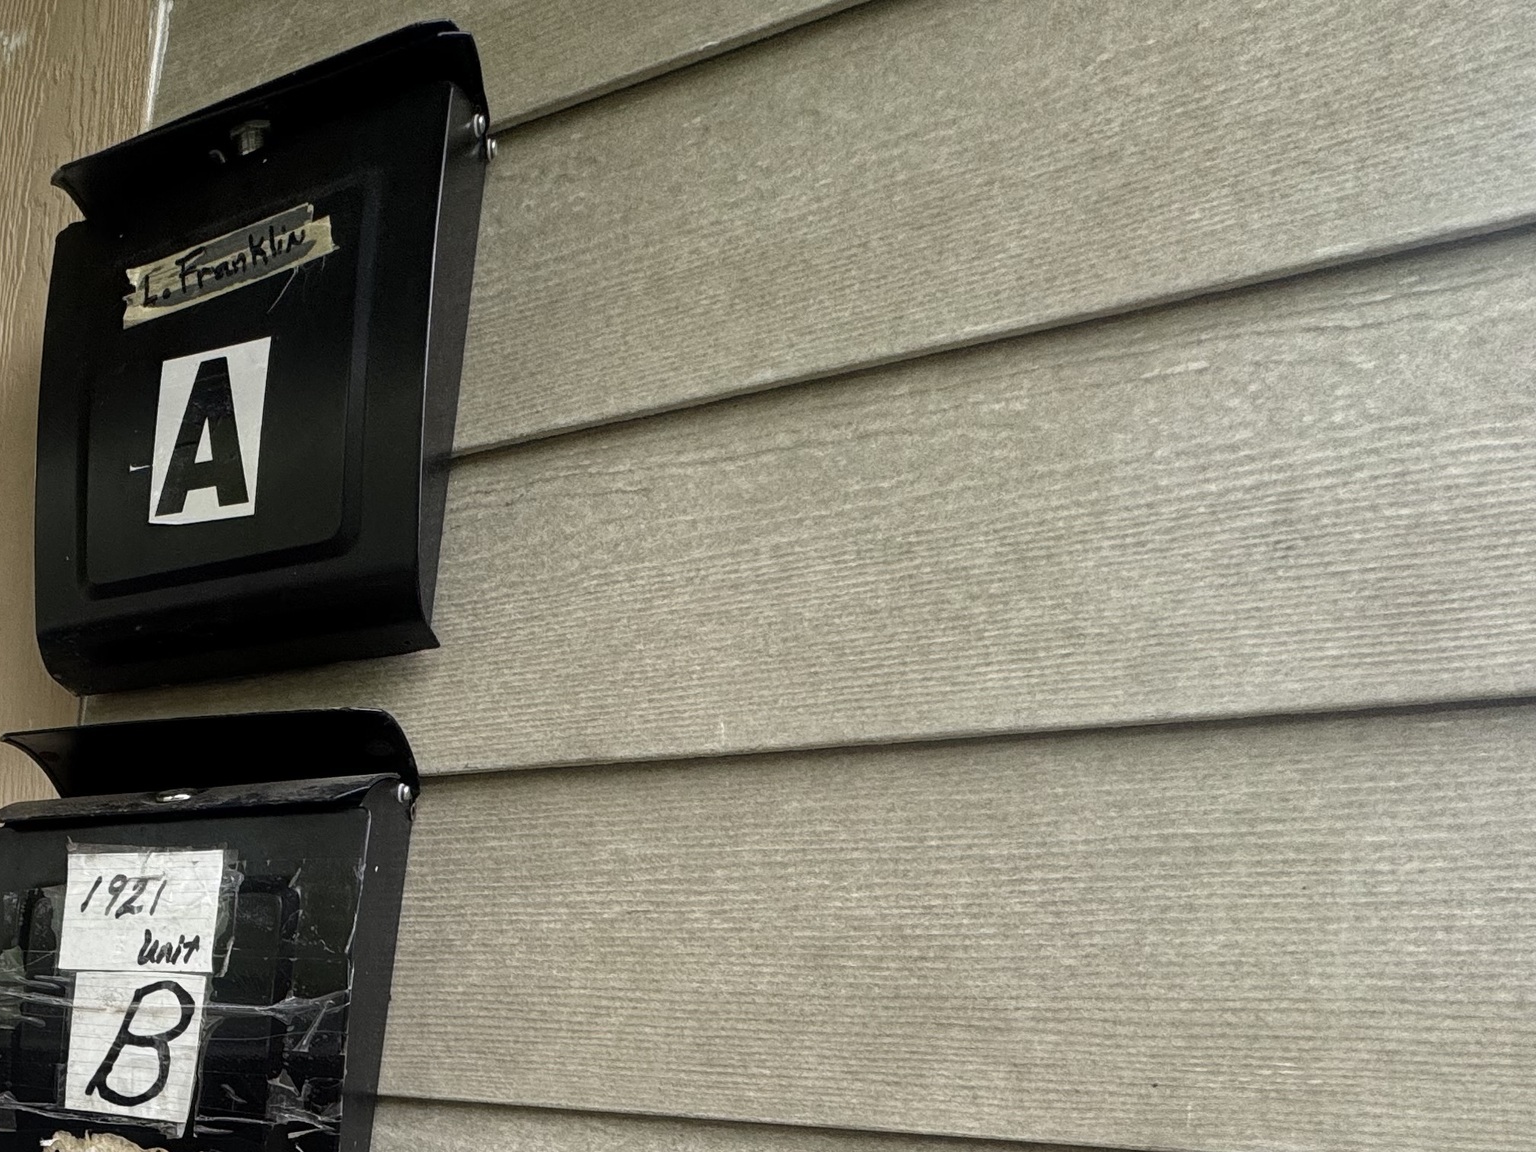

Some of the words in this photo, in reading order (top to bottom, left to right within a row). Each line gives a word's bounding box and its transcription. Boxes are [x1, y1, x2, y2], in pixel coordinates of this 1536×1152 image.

[175, 225, 305, 293] Franklin
[155, 356, 249, 517] A
[81, 873, 168, 919] 1921
[84, 980, 196, 1107] B
